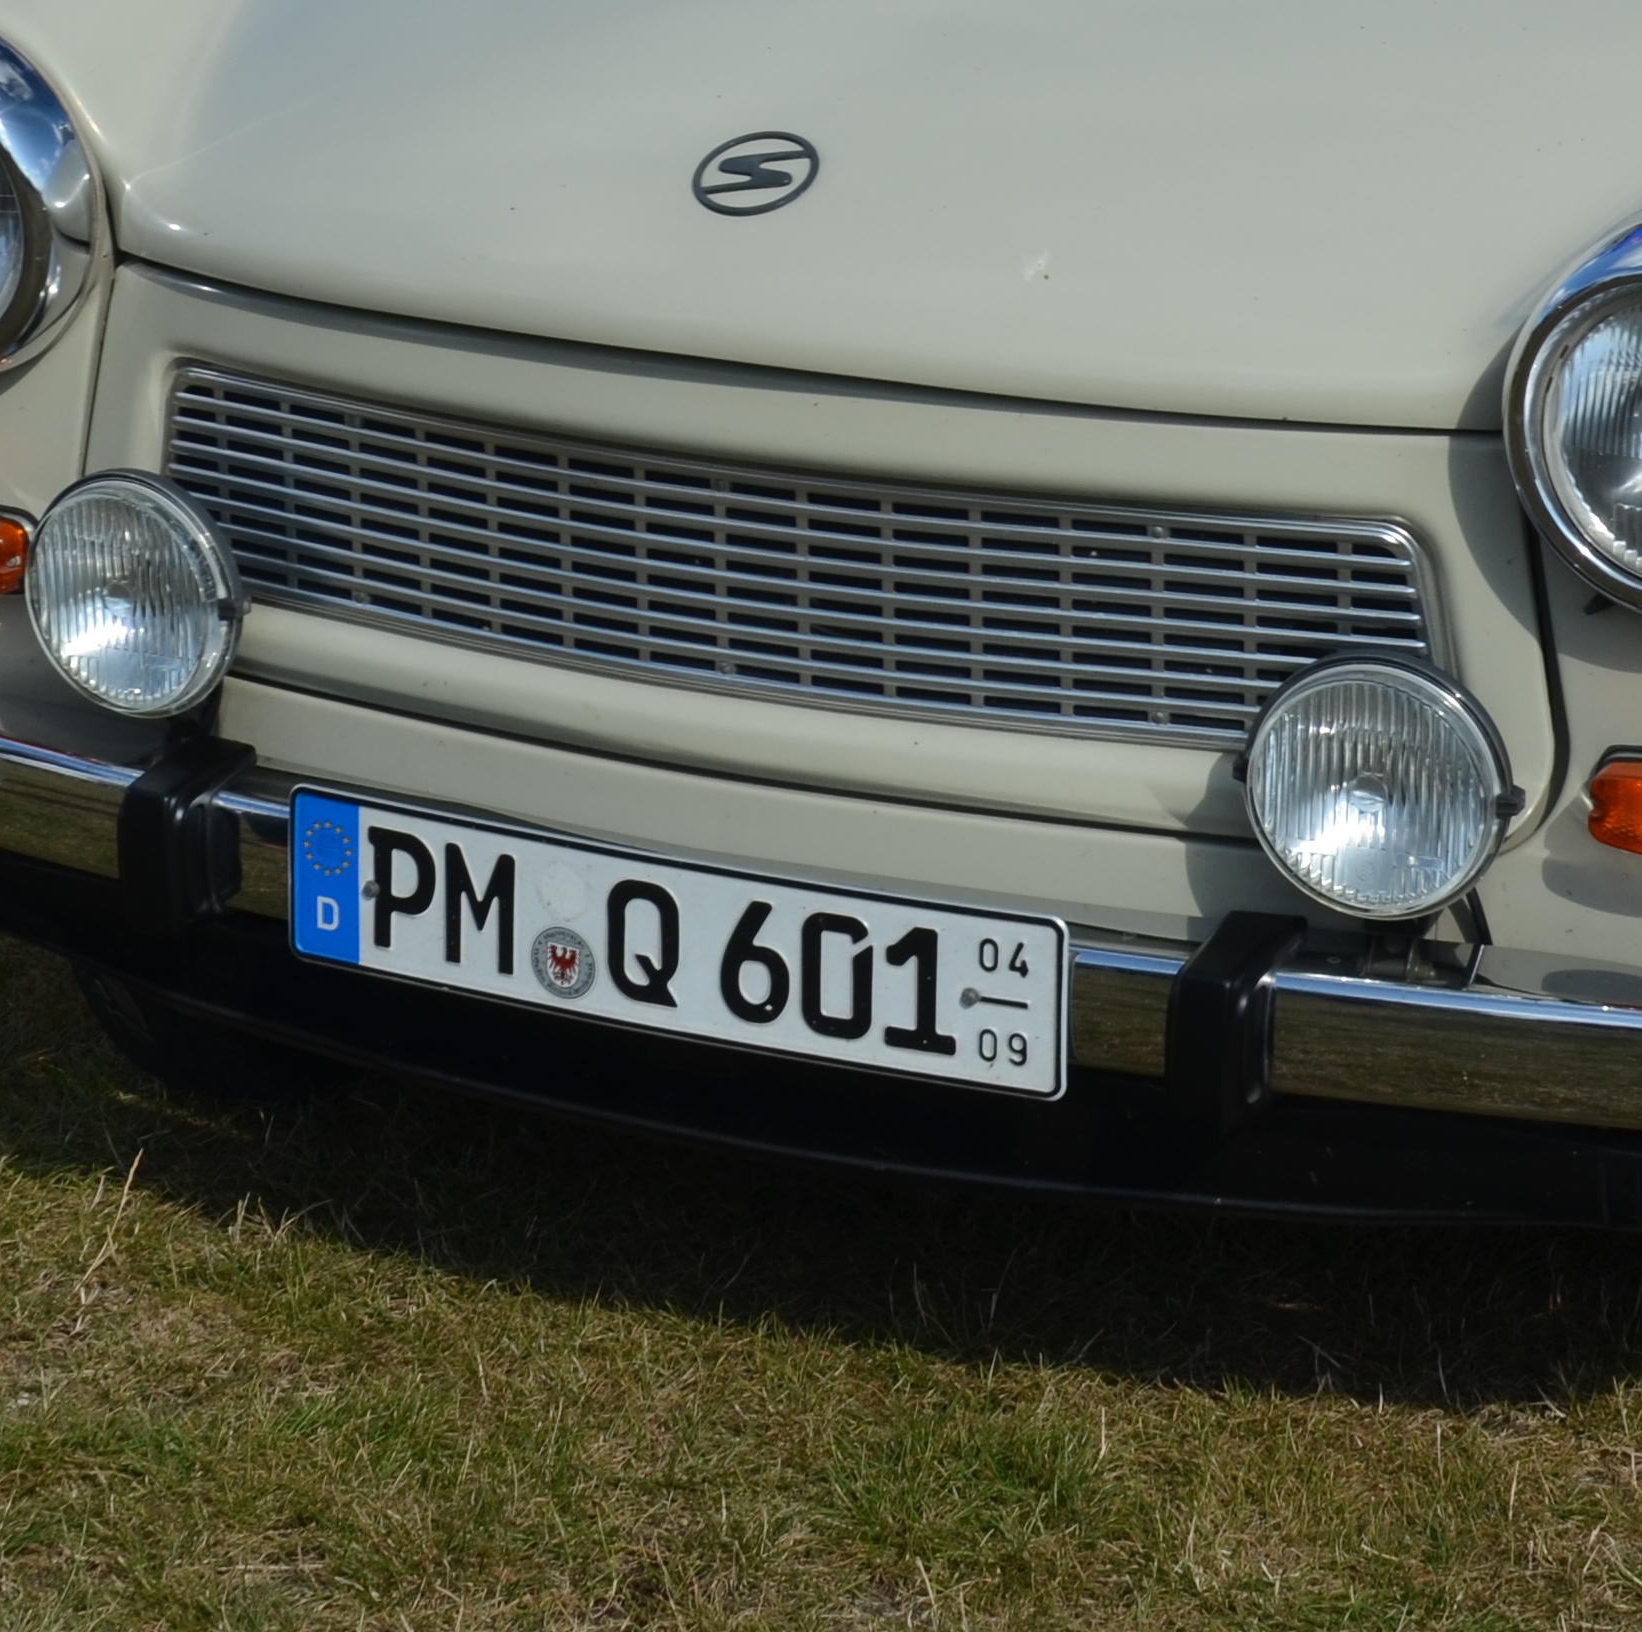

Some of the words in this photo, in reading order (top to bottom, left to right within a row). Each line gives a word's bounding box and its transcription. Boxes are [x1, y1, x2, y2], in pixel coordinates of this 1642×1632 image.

[317, 895, 340, 932] D
[367, 825, 515, 975] PM
[606, 878, 679, 1008] Q
[720, 901, 957, 1056] 601
[978, 938, 1029, 978] 04
[978, 1028, 1028, 1067] 09
